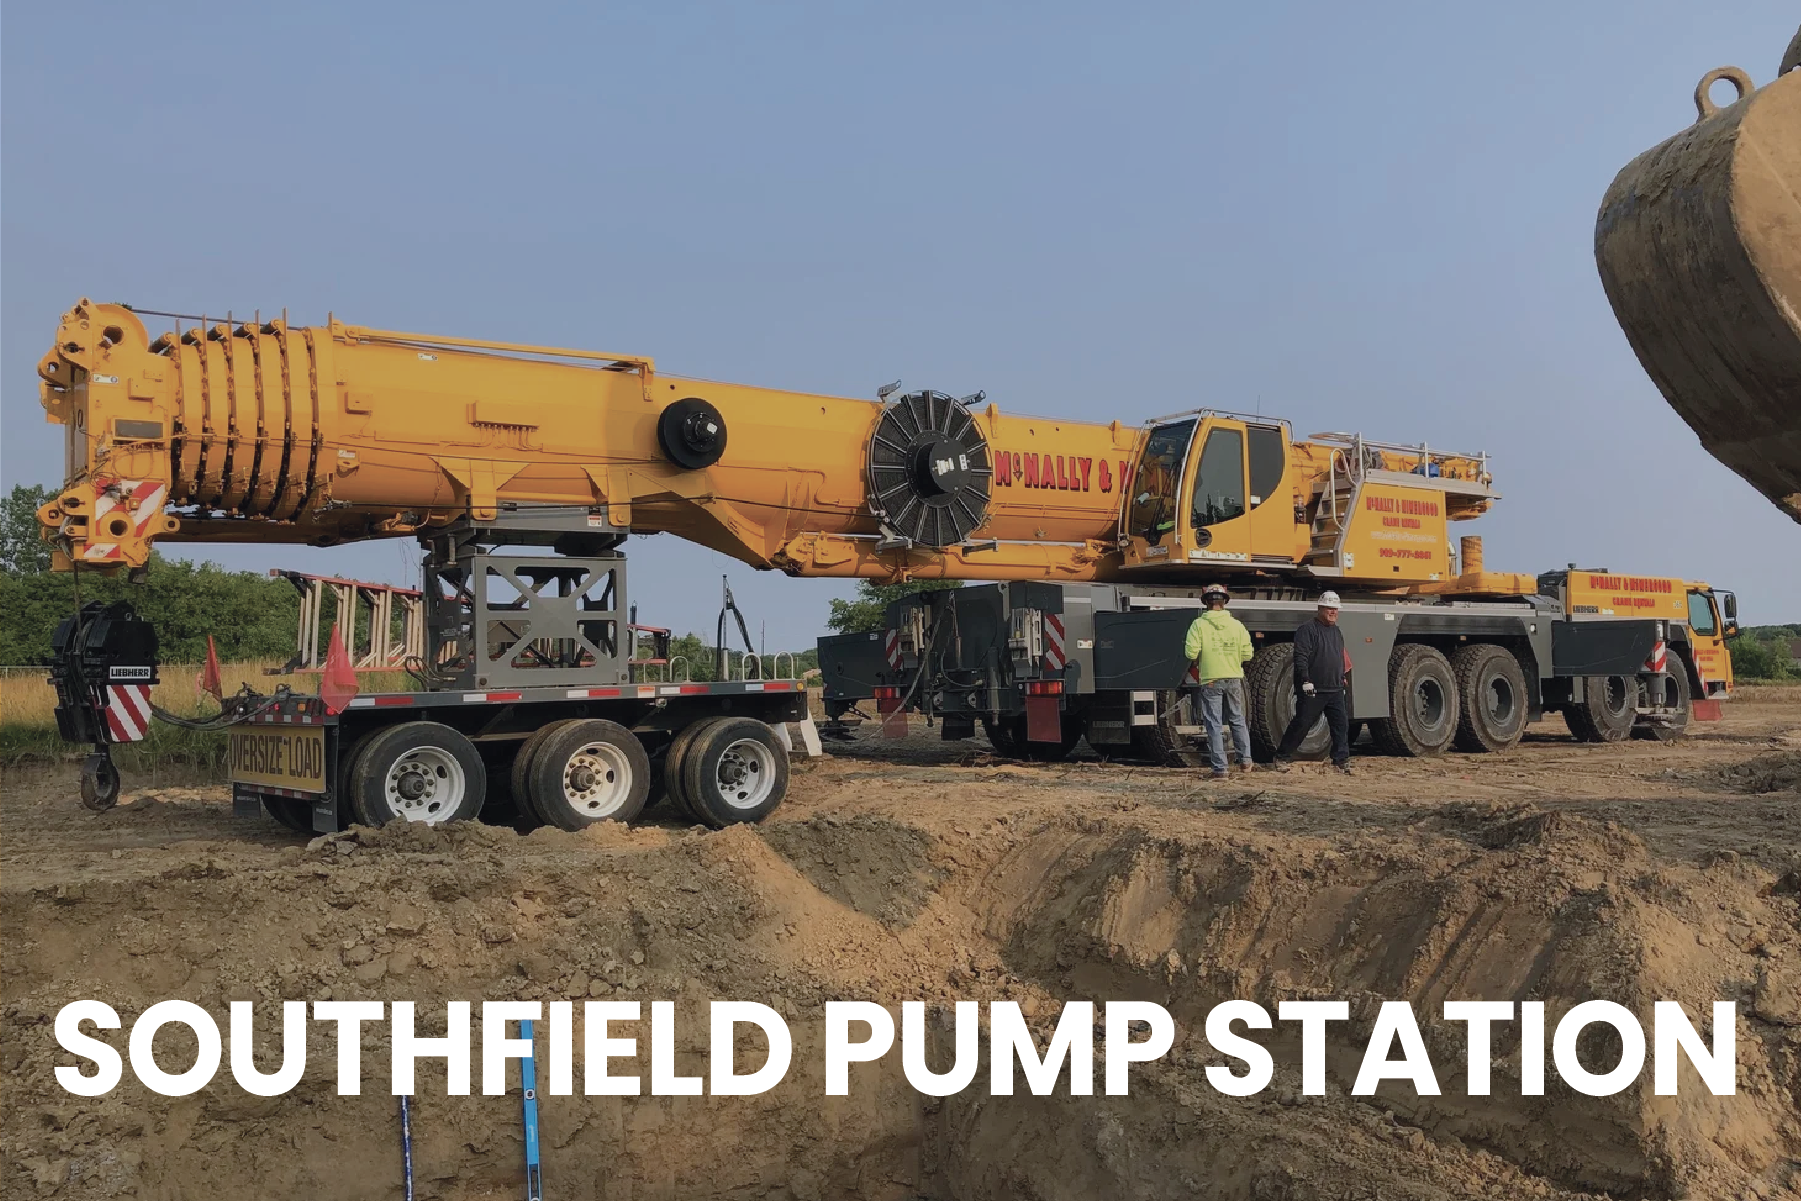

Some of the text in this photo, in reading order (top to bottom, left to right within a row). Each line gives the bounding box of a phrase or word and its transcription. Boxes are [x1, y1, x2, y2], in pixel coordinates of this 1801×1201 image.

[1099, 458, 1112, 493] &
[111, 668, 149, 677] LIEBHERR
[231, 734, 322, 779] OVERSIZE LOAD
